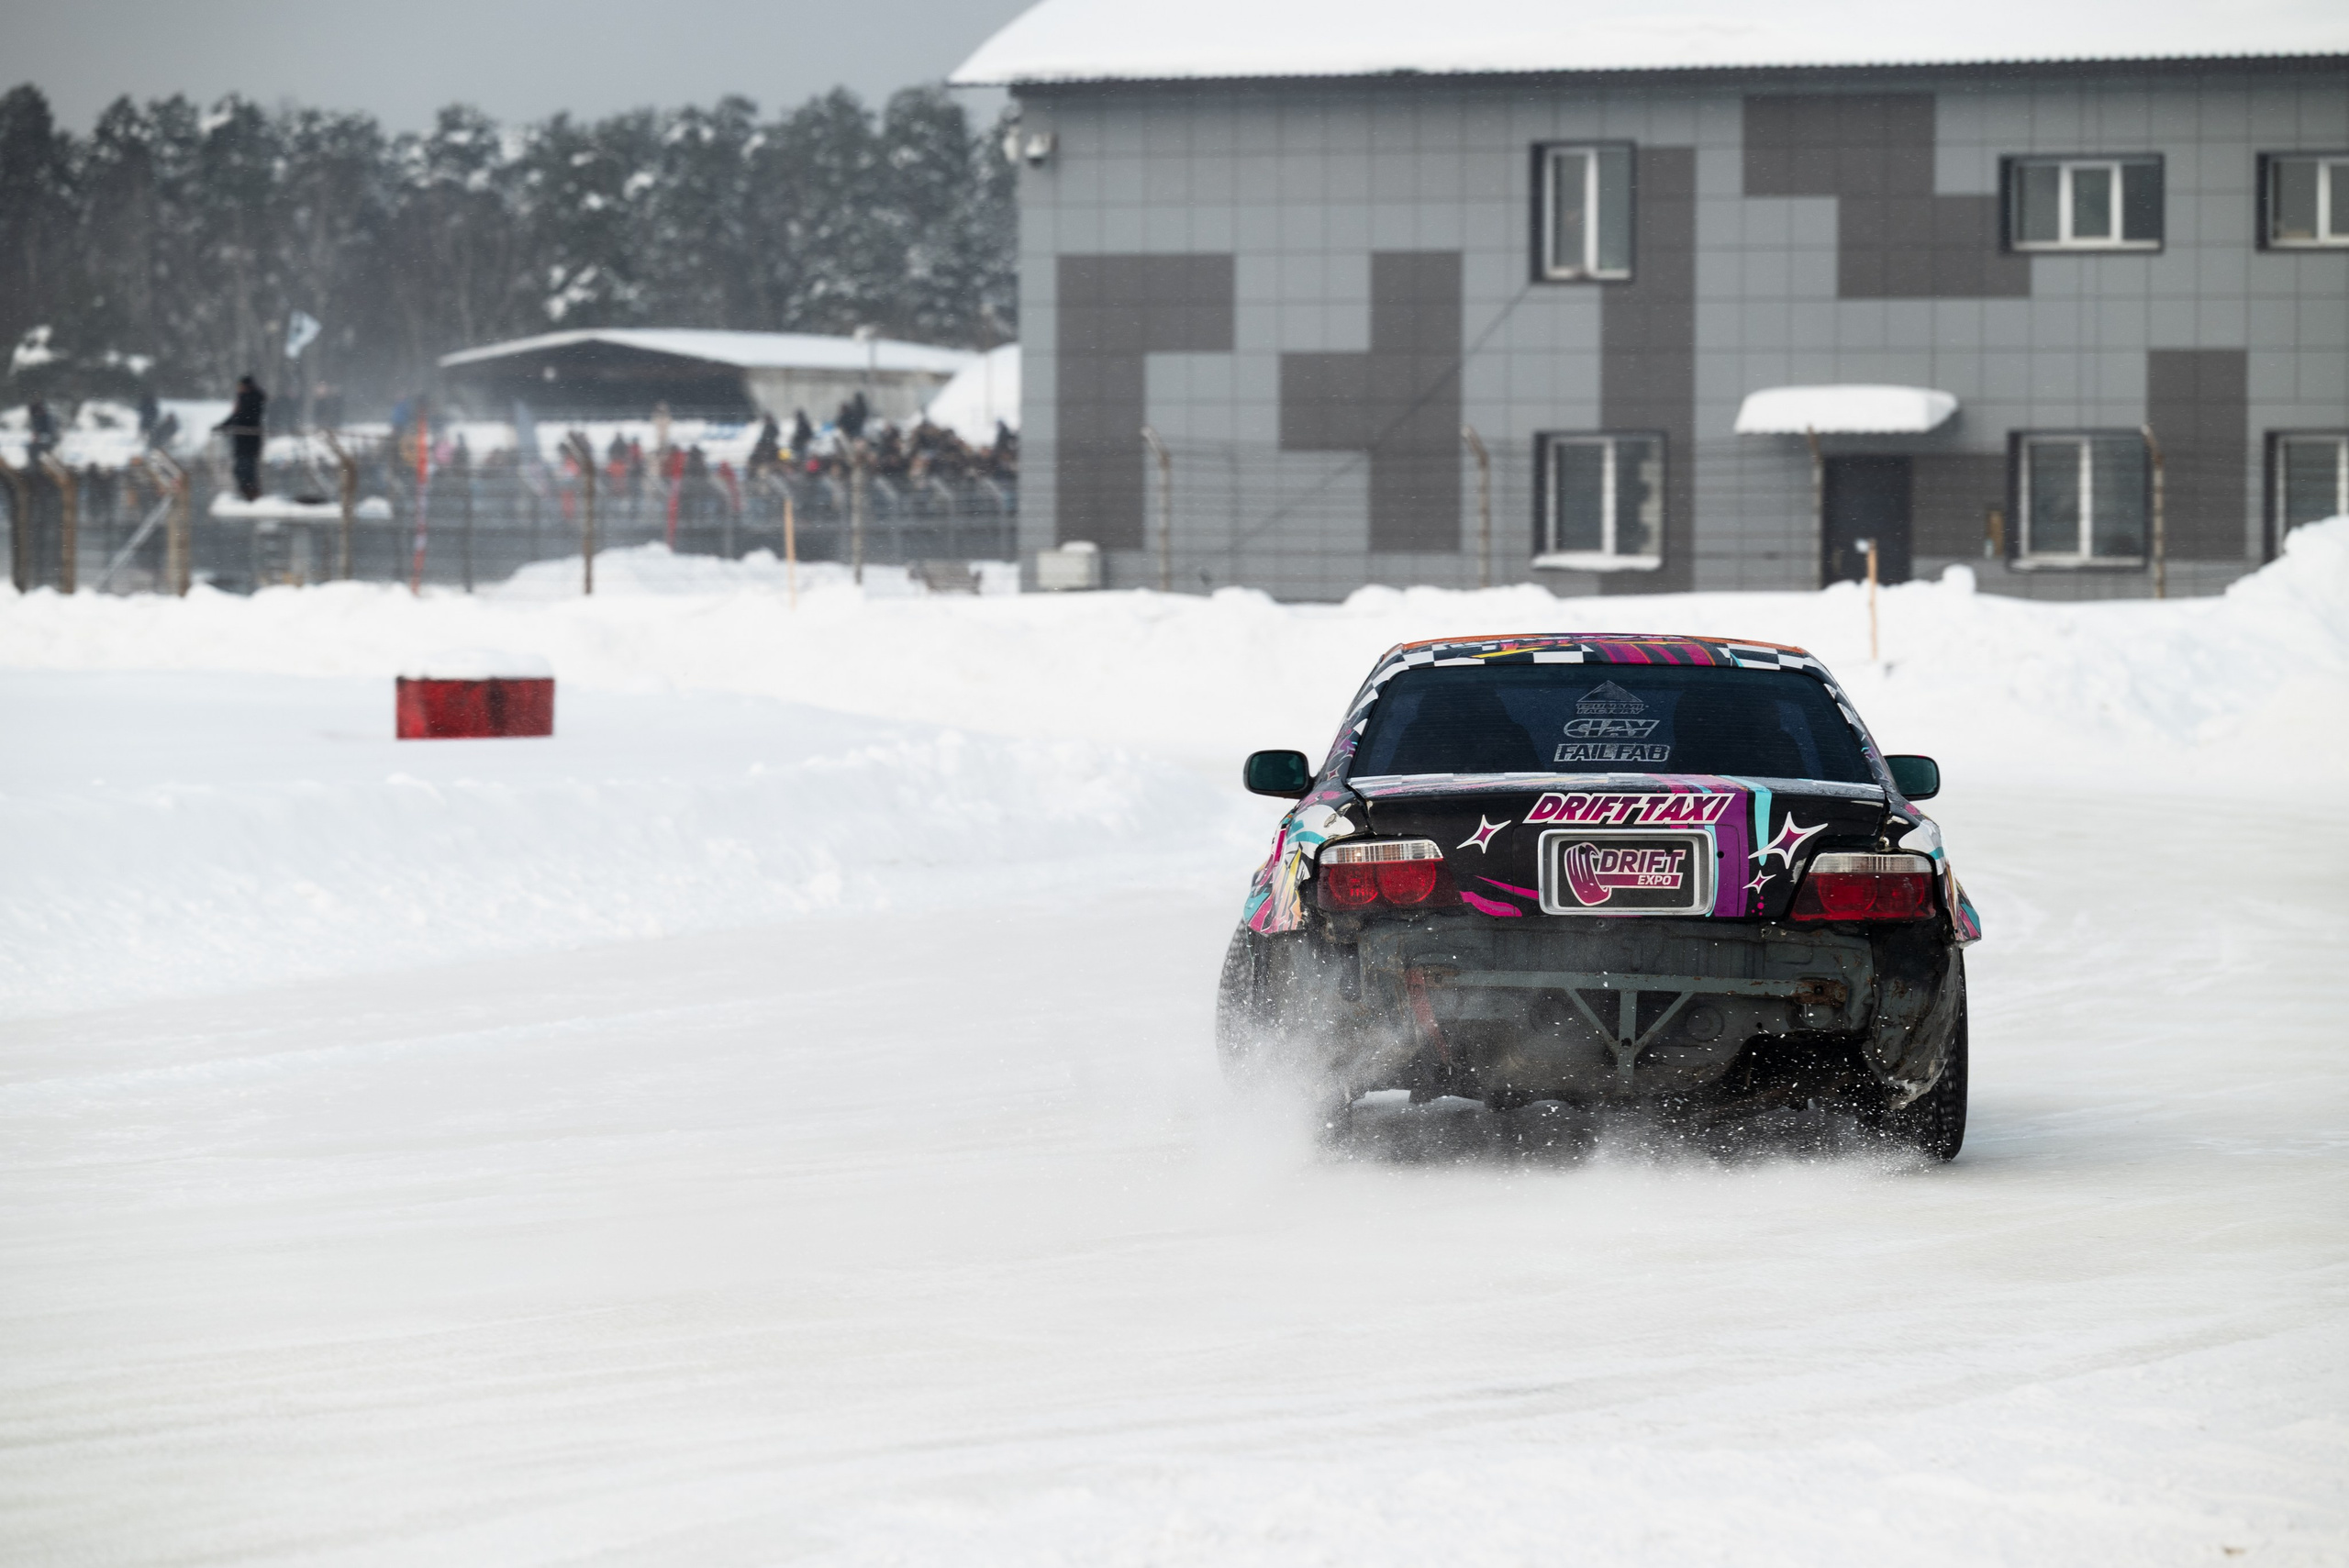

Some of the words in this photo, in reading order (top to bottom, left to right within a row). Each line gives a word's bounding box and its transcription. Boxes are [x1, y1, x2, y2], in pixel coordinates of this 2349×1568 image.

[1523, 793, 1643, 824] DRIFT
[1634, 793, 1735, 824] TAXI
[1598, 849, 1687, 873] DRIFT
[1638, 874, 1673, 885] EXPO
